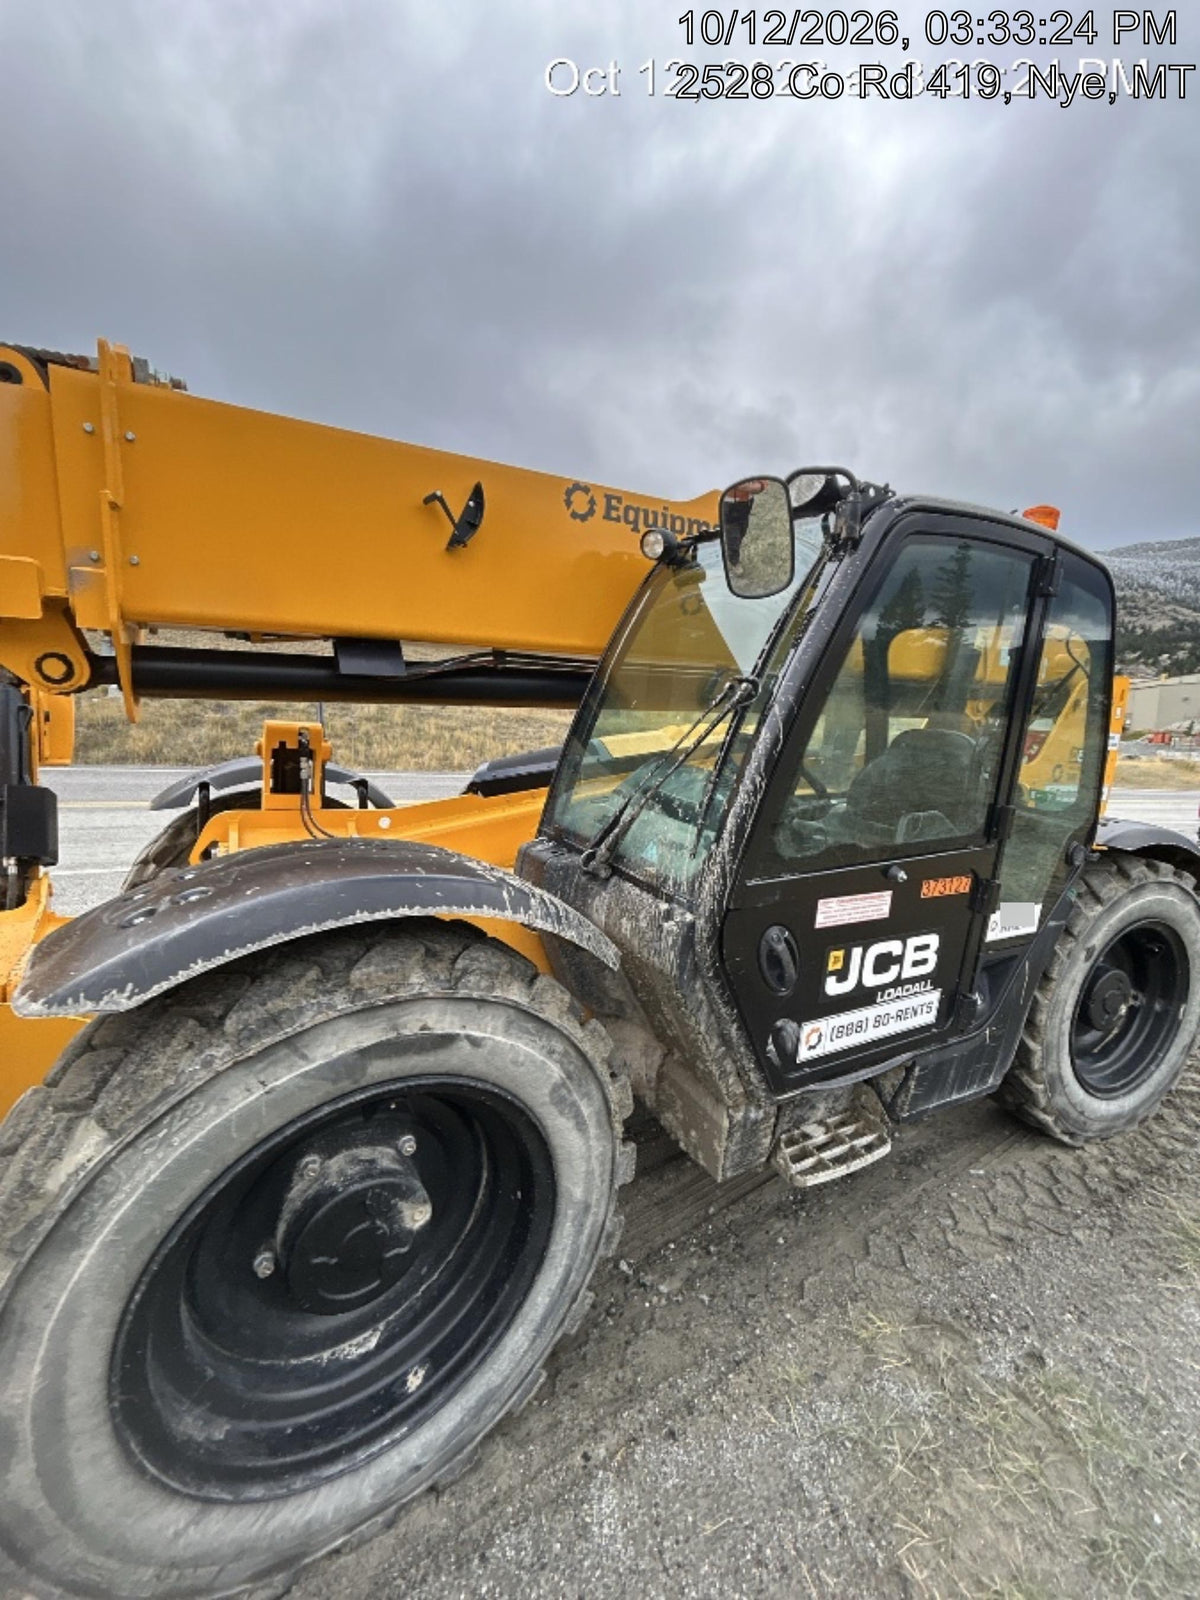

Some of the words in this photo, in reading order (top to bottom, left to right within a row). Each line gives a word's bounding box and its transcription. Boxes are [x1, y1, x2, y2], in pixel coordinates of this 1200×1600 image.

[602, 494, 720, 535] Equipm
[824, 933, 940, 996] JCB
[876, 979, 935, 1003] LOADALL
[829, 1017, 869, 1042] (888)
[872, 1001, 935, 1029] 80-RENTS
